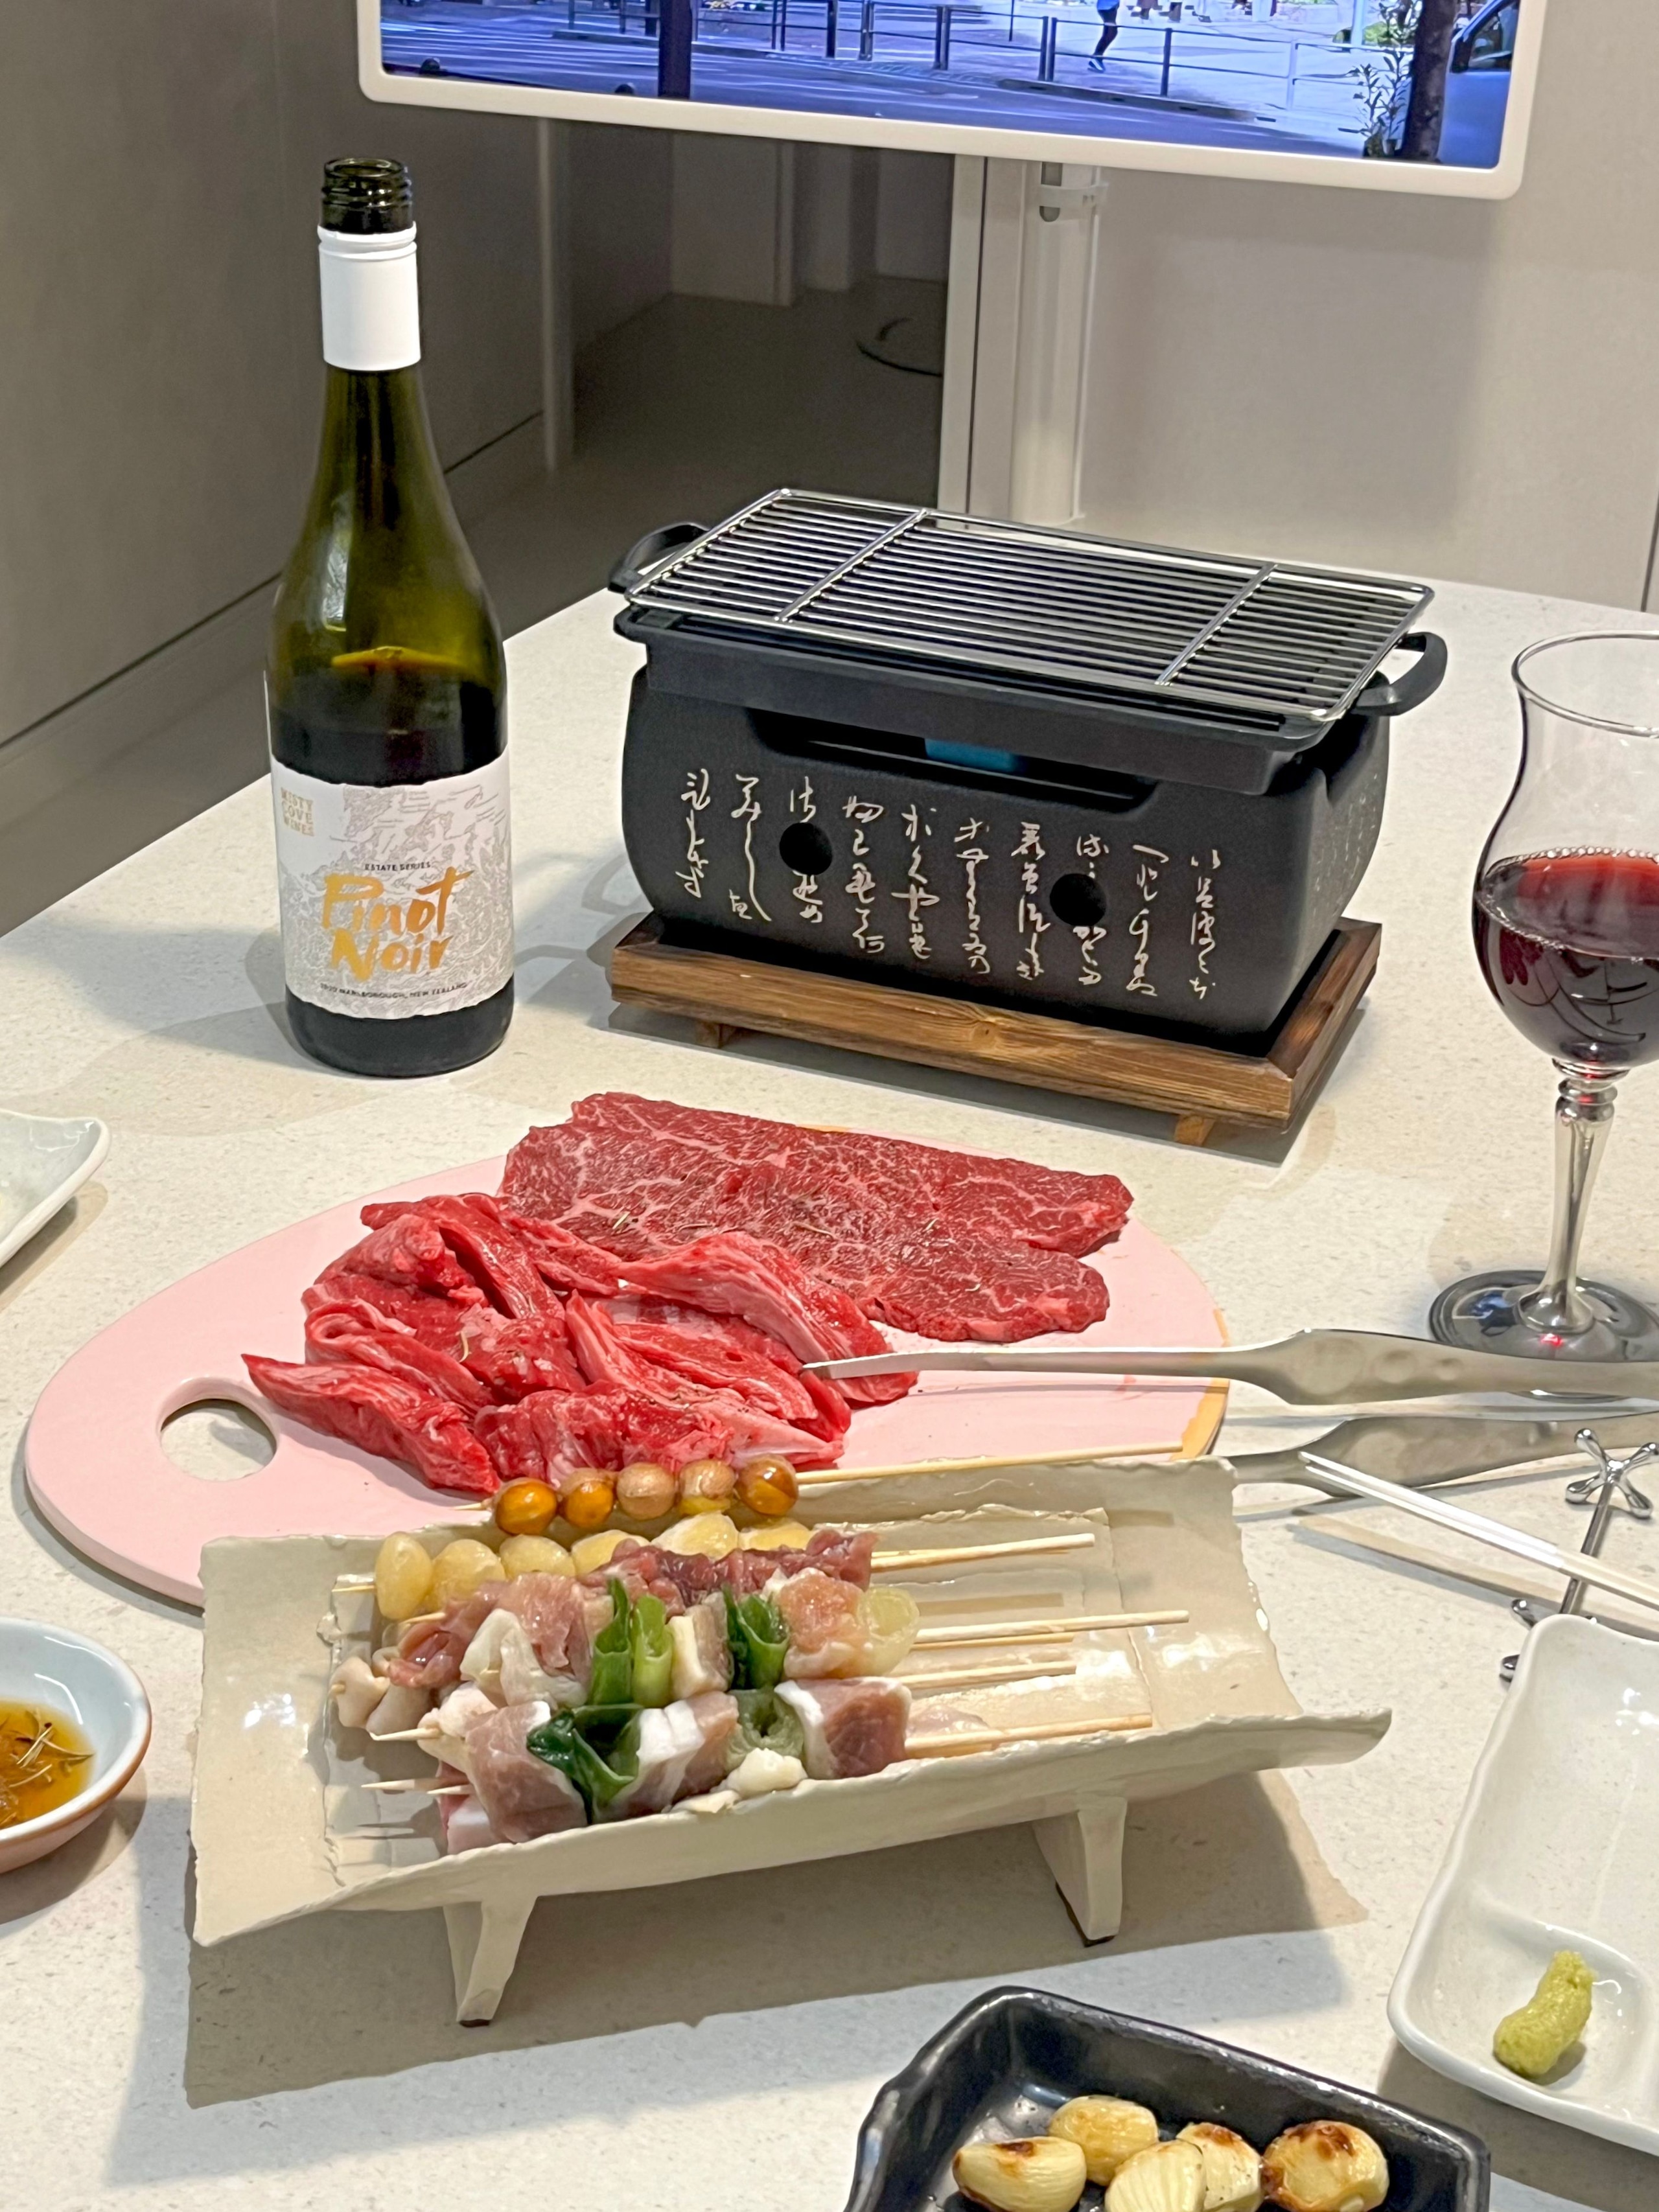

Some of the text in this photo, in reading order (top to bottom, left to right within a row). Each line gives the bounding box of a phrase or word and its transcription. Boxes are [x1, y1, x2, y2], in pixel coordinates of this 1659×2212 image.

[282, 800, 313, 824] COVE
[284, 816, 314, 836] WINES
[365, 862, 430, 871] ESTATE SERIES
[322, 866, 475, 936] Pinot
[331, 927, 454, 983] Noir
[432, 982, 467, 995] ZEALAND
